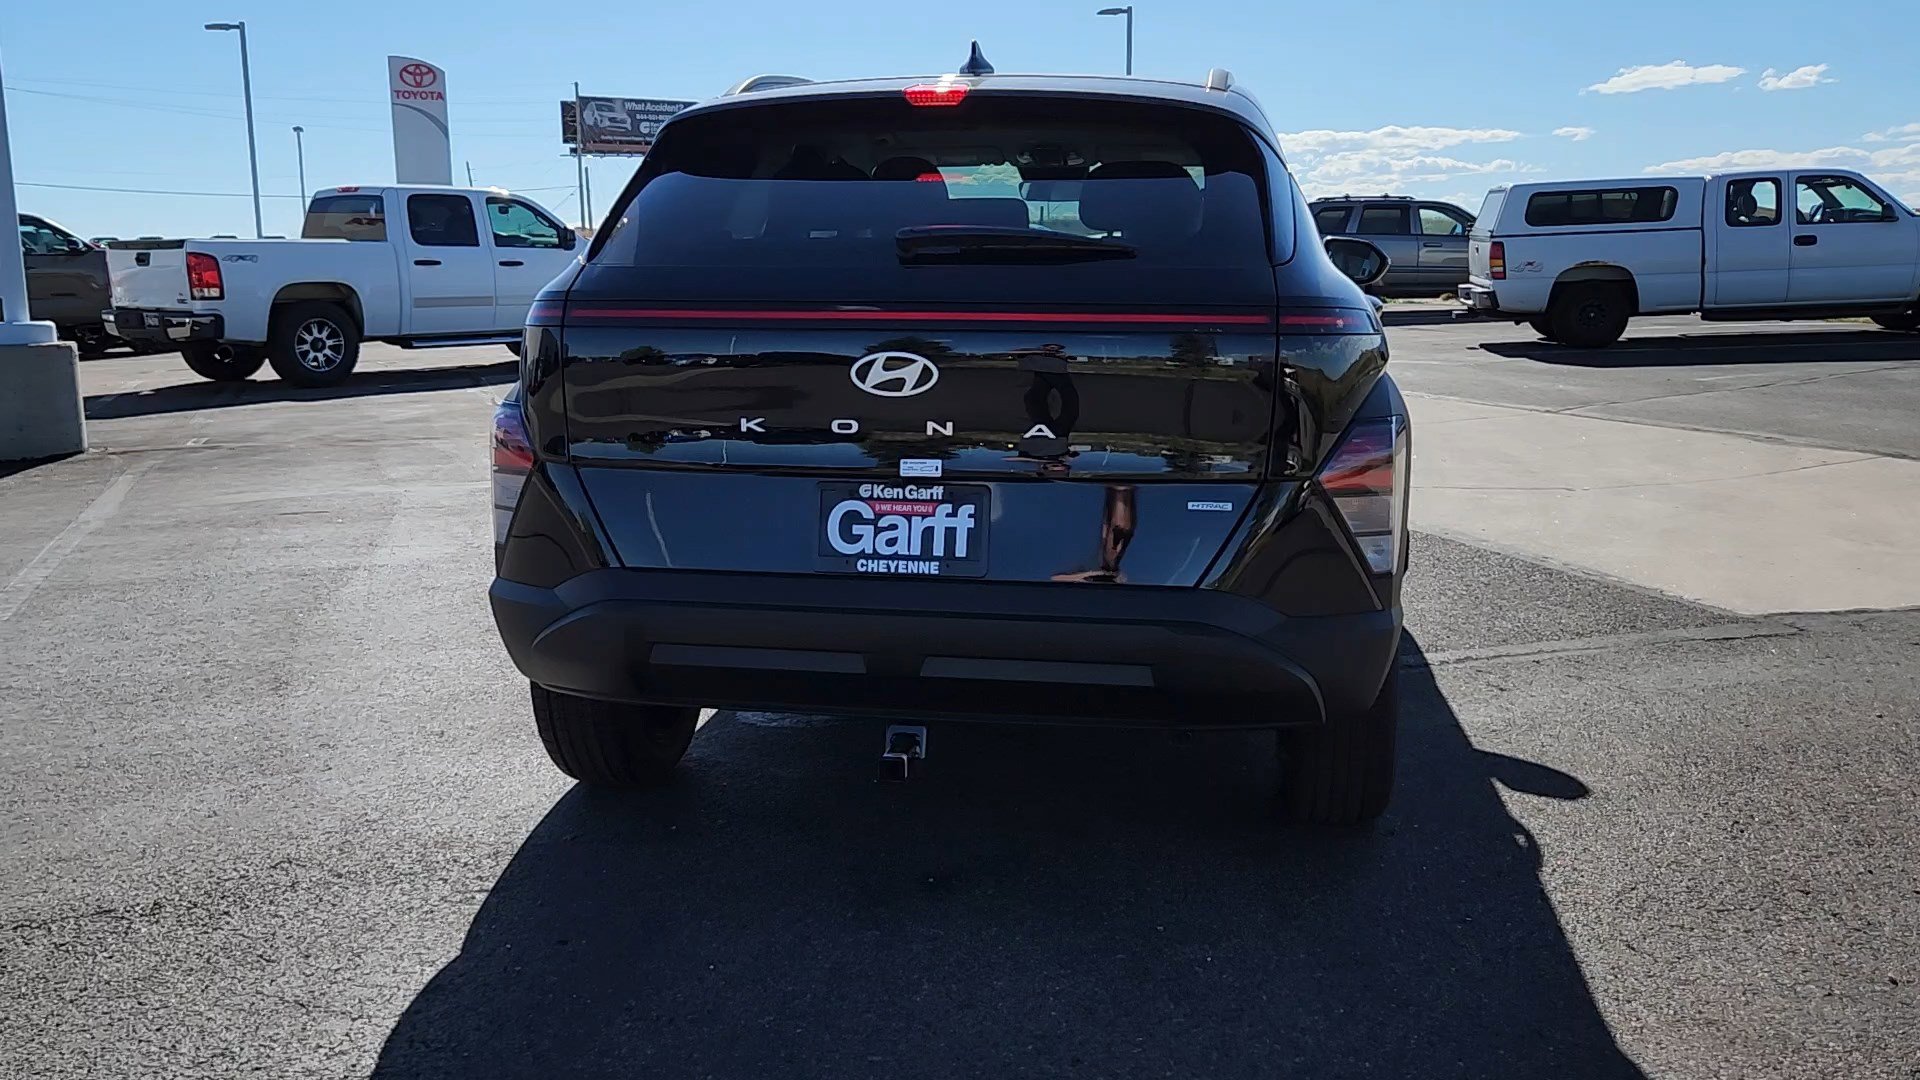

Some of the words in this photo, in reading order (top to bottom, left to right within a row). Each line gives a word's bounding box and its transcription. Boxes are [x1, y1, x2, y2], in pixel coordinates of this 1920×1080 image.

[393, 90, 444, 101] TOYOTA
[624, 102, 644, 111] What
[740, 418, 1057, 439] KONA
[873, 485, 903, 499] Ken
[904, 485, 944, 500] Garff
[892, 504, 912, 512] HEAR
[912, 505, 928, 513] YOU
[827, 500, 975, 557] Garff
[857, 559, 940, 574] CHEYENNE
